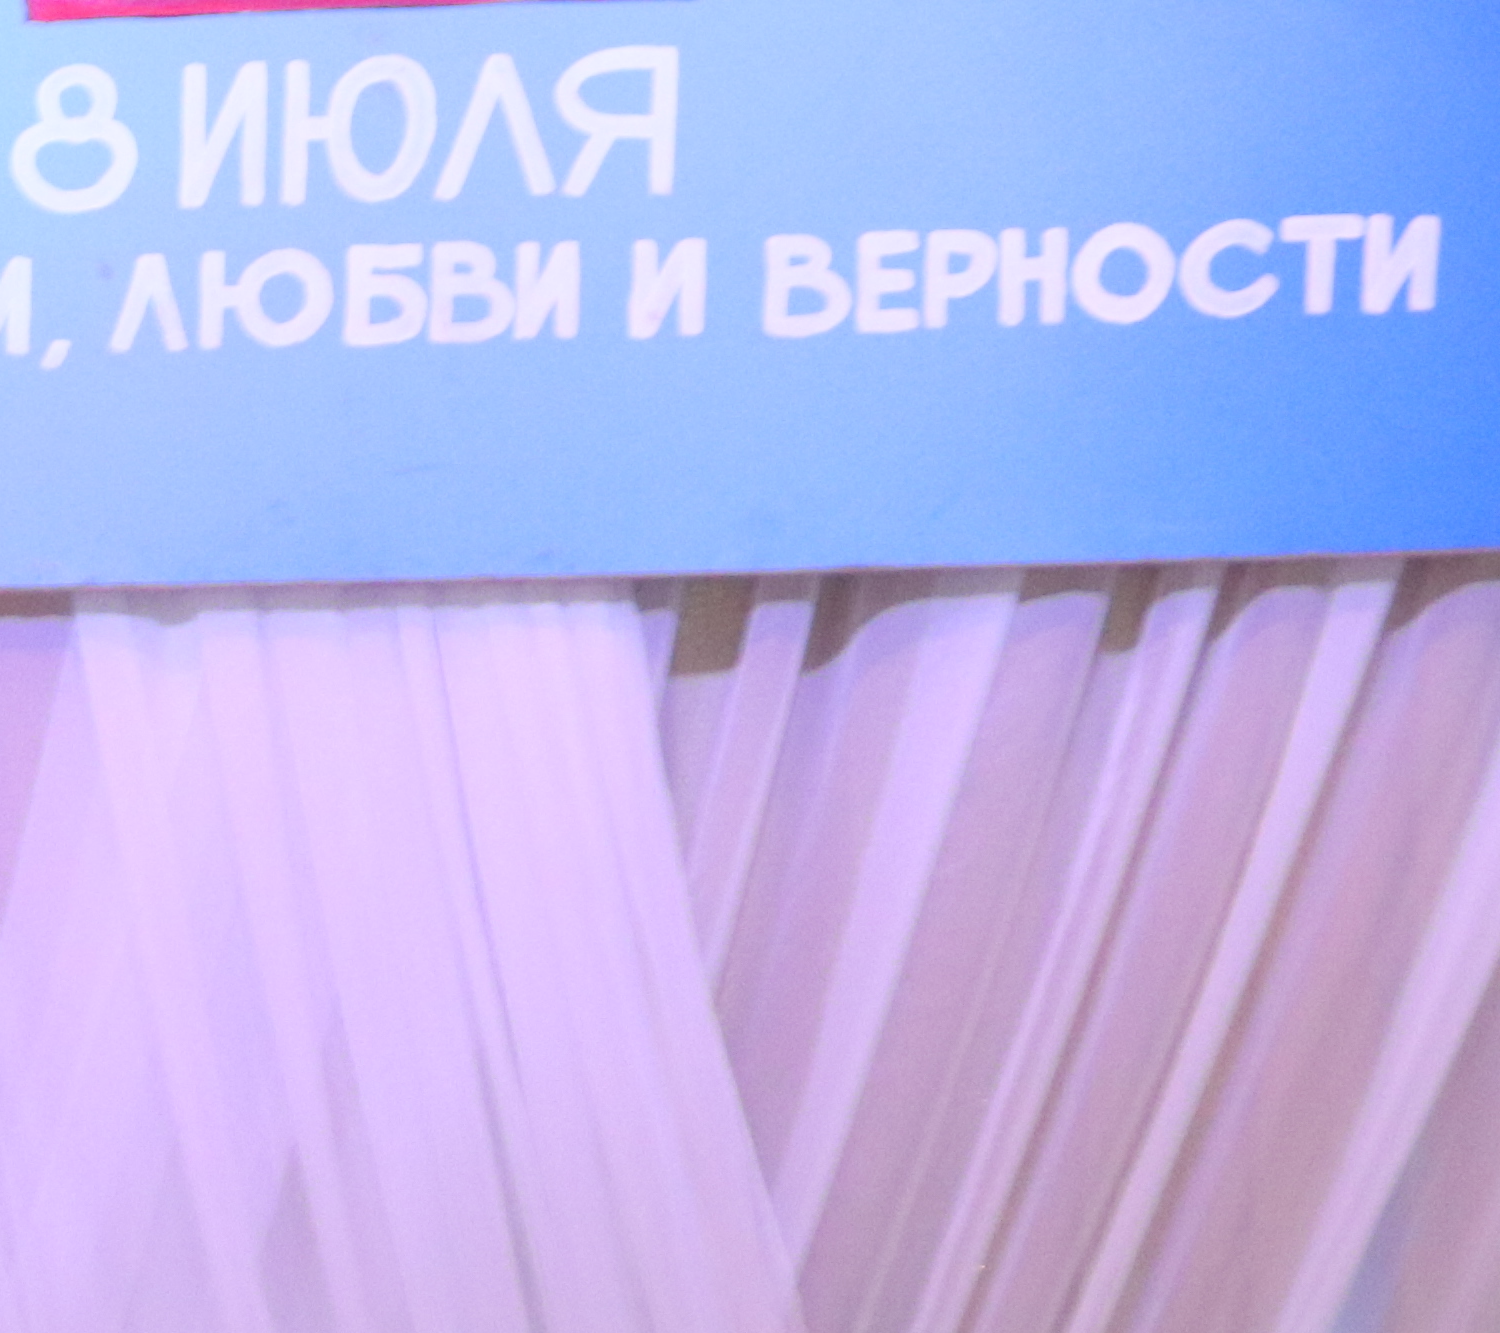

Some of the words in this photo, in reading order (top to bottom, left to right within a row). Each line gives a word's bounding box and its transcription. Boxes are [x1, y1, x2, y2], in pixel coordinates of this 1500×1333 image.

[10, 63, 138, 214] 8
[178, 44, 679, 209] ИЮЛЯ
[110, 240, 580, 353] ЛЮБВИ
[628, 237, 706, 340] И
[763, 213, 1438, 338] ВЕРНОСТИ
